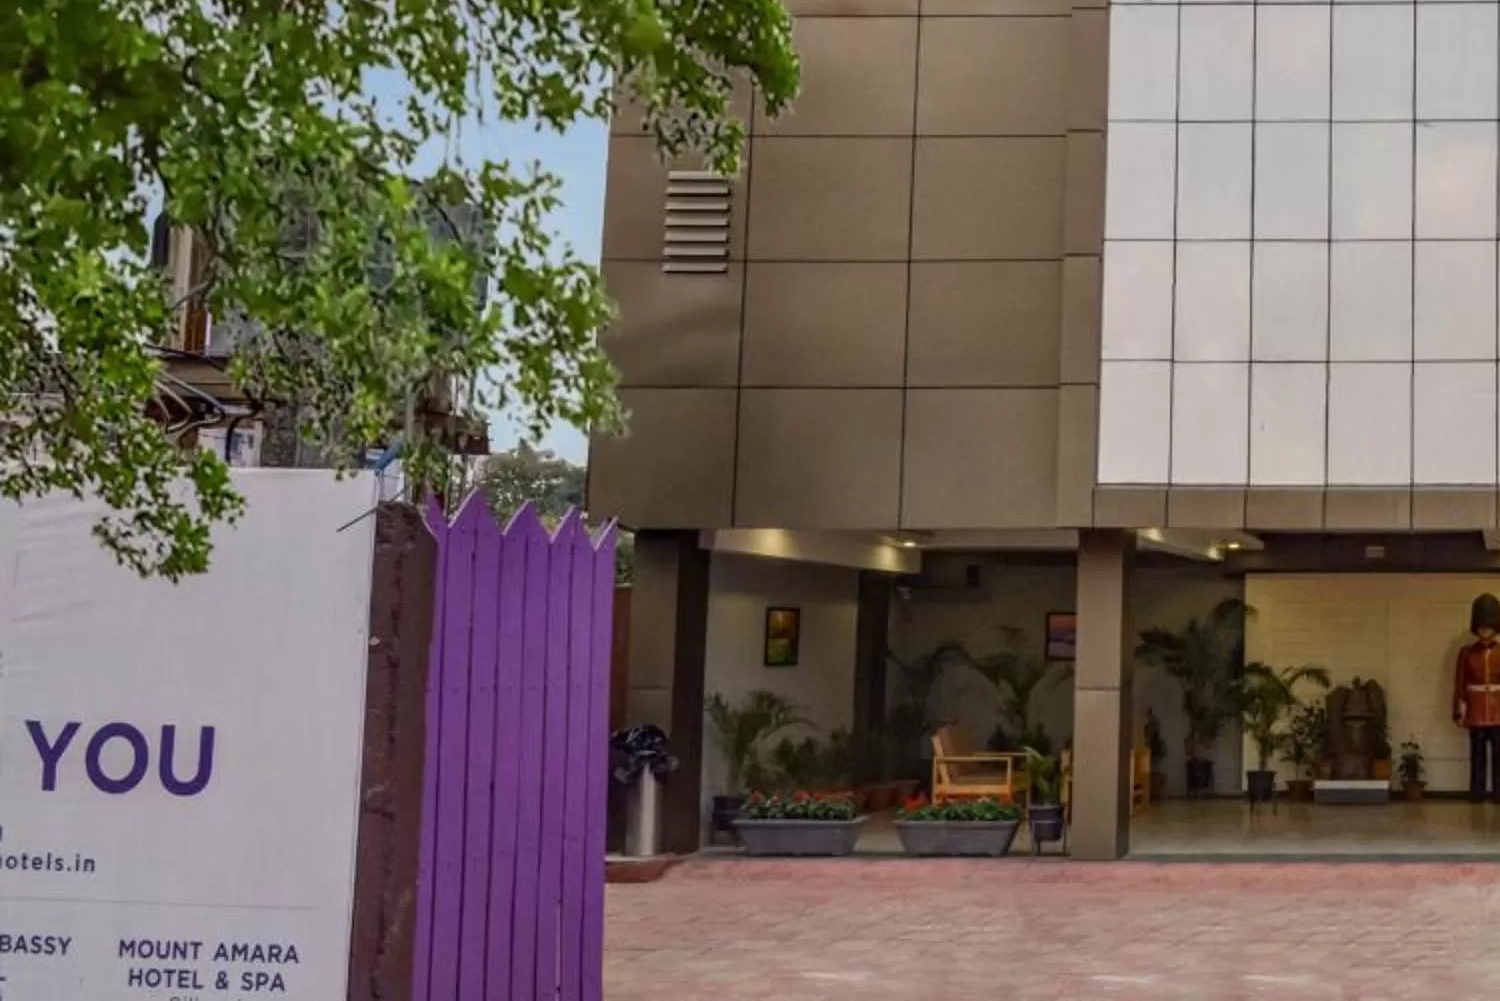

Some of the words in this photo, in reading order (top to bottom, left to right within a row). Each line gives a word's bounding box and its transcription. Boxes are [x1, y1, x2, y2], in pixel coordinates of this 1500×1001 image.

[25, 721, 216, 796] YOU
[0, 853, 96, 873] otels.in
[118, 939, 203, 960] MOUNT
[212, 943, 300, 964] AMARA
[127, 968, 205, 989] HOTEL
[215, 971, 229, 990] &
[240, 972, 285, 992] SPA
